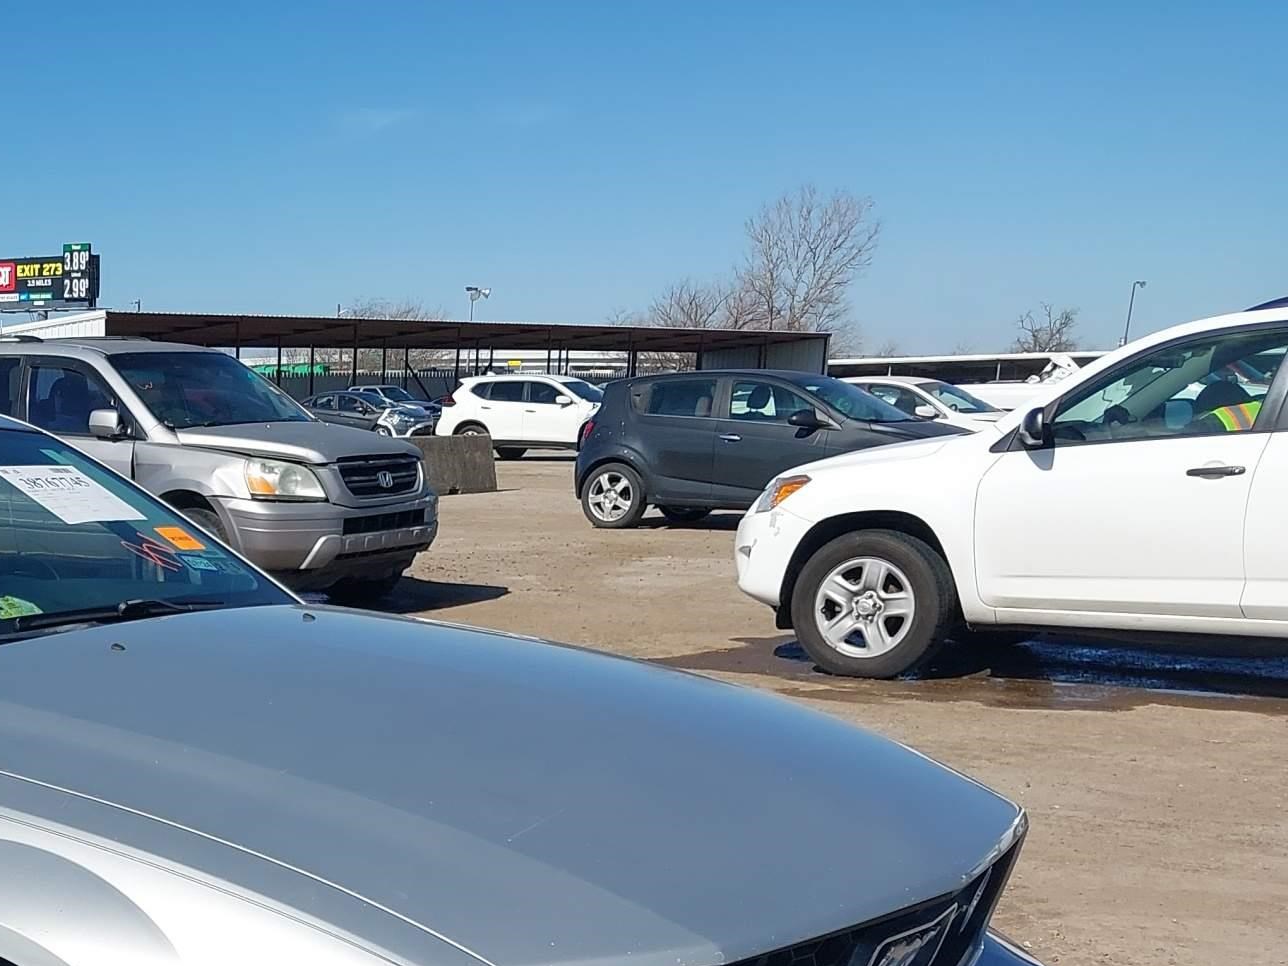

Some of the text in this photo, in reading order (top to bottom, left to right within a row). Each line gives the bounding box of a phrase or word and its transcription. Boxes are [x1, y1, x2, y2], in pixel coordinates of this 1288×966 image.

[17, 264, 41, 277] EXIT
[42, 262, 63, 276] 273
[35, 278, 52, 287] MILES
[19, 477, 90, 489] 38767745
